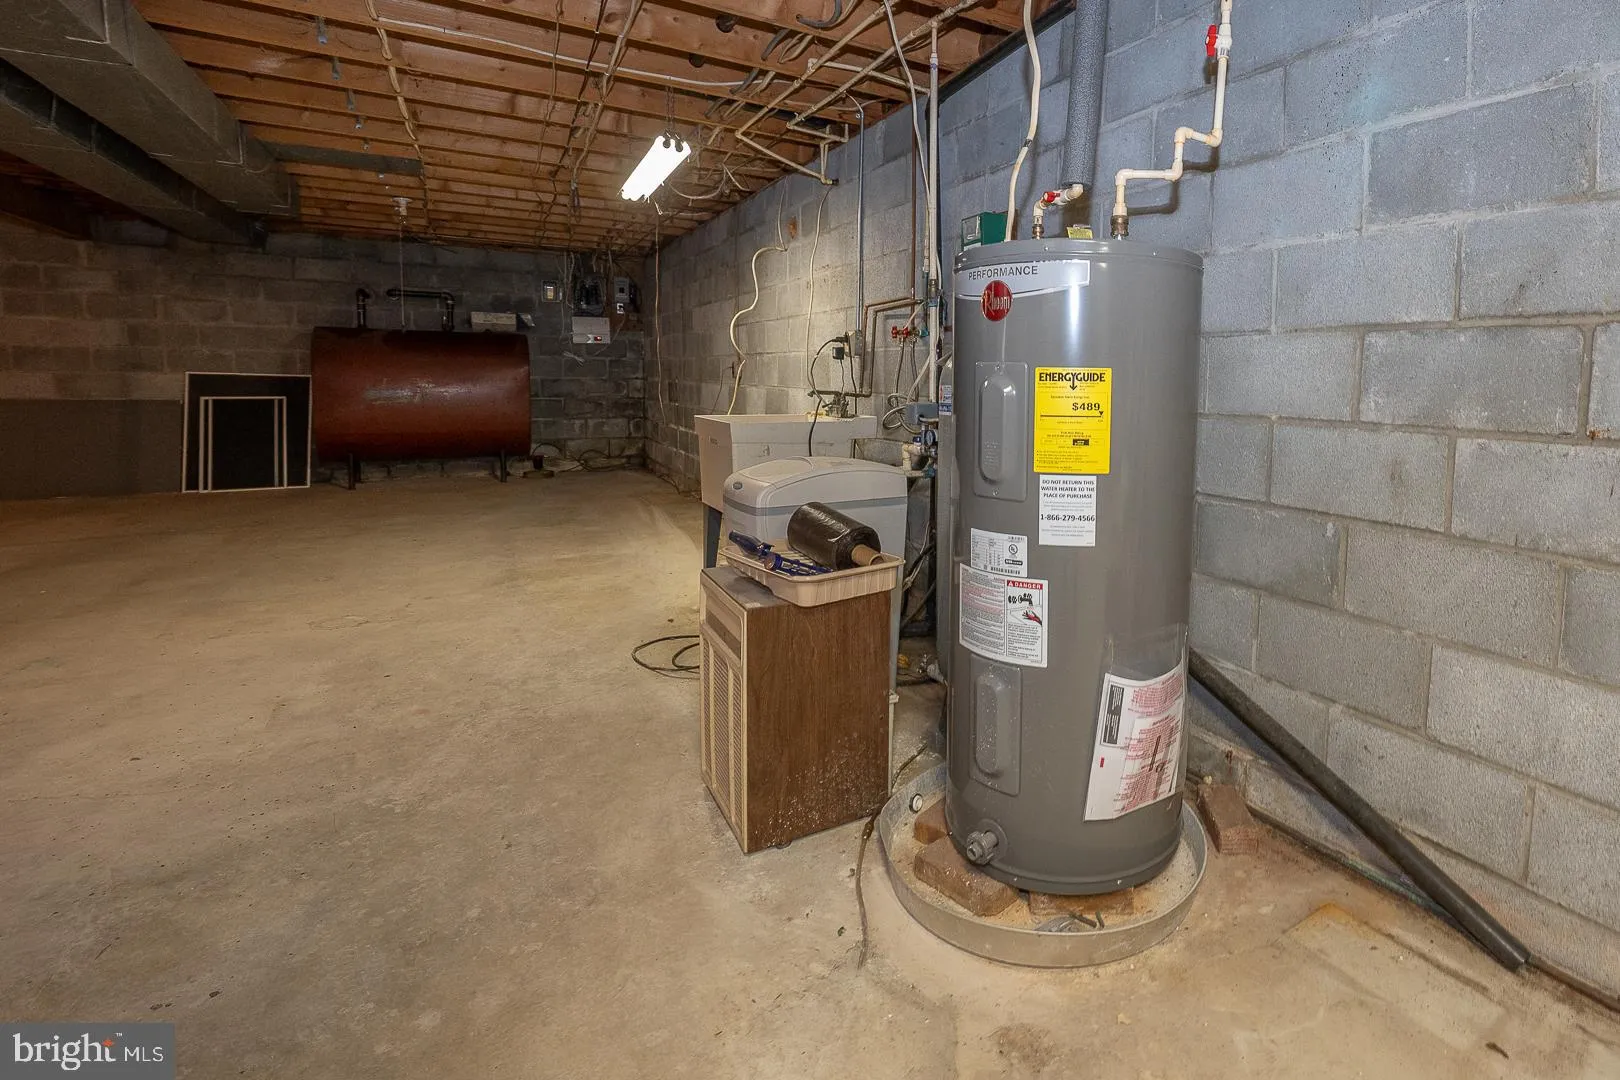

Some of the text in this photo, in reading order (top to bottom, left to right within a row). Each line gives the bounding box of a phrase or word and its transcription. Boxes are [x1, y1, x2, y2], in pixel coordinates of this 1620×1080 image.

[968, 265, 1039, 281] PERFORMANCE
[983, 284, 1010, 315] Rheem
[1039, 372, 1106, 383] ENERGYGUIDE
[1072, 402, 1100, 411] $489
[1040, 513, 1095, 521] 1-866-279-4566
[1014, 581, 1041, 590] DANGER
